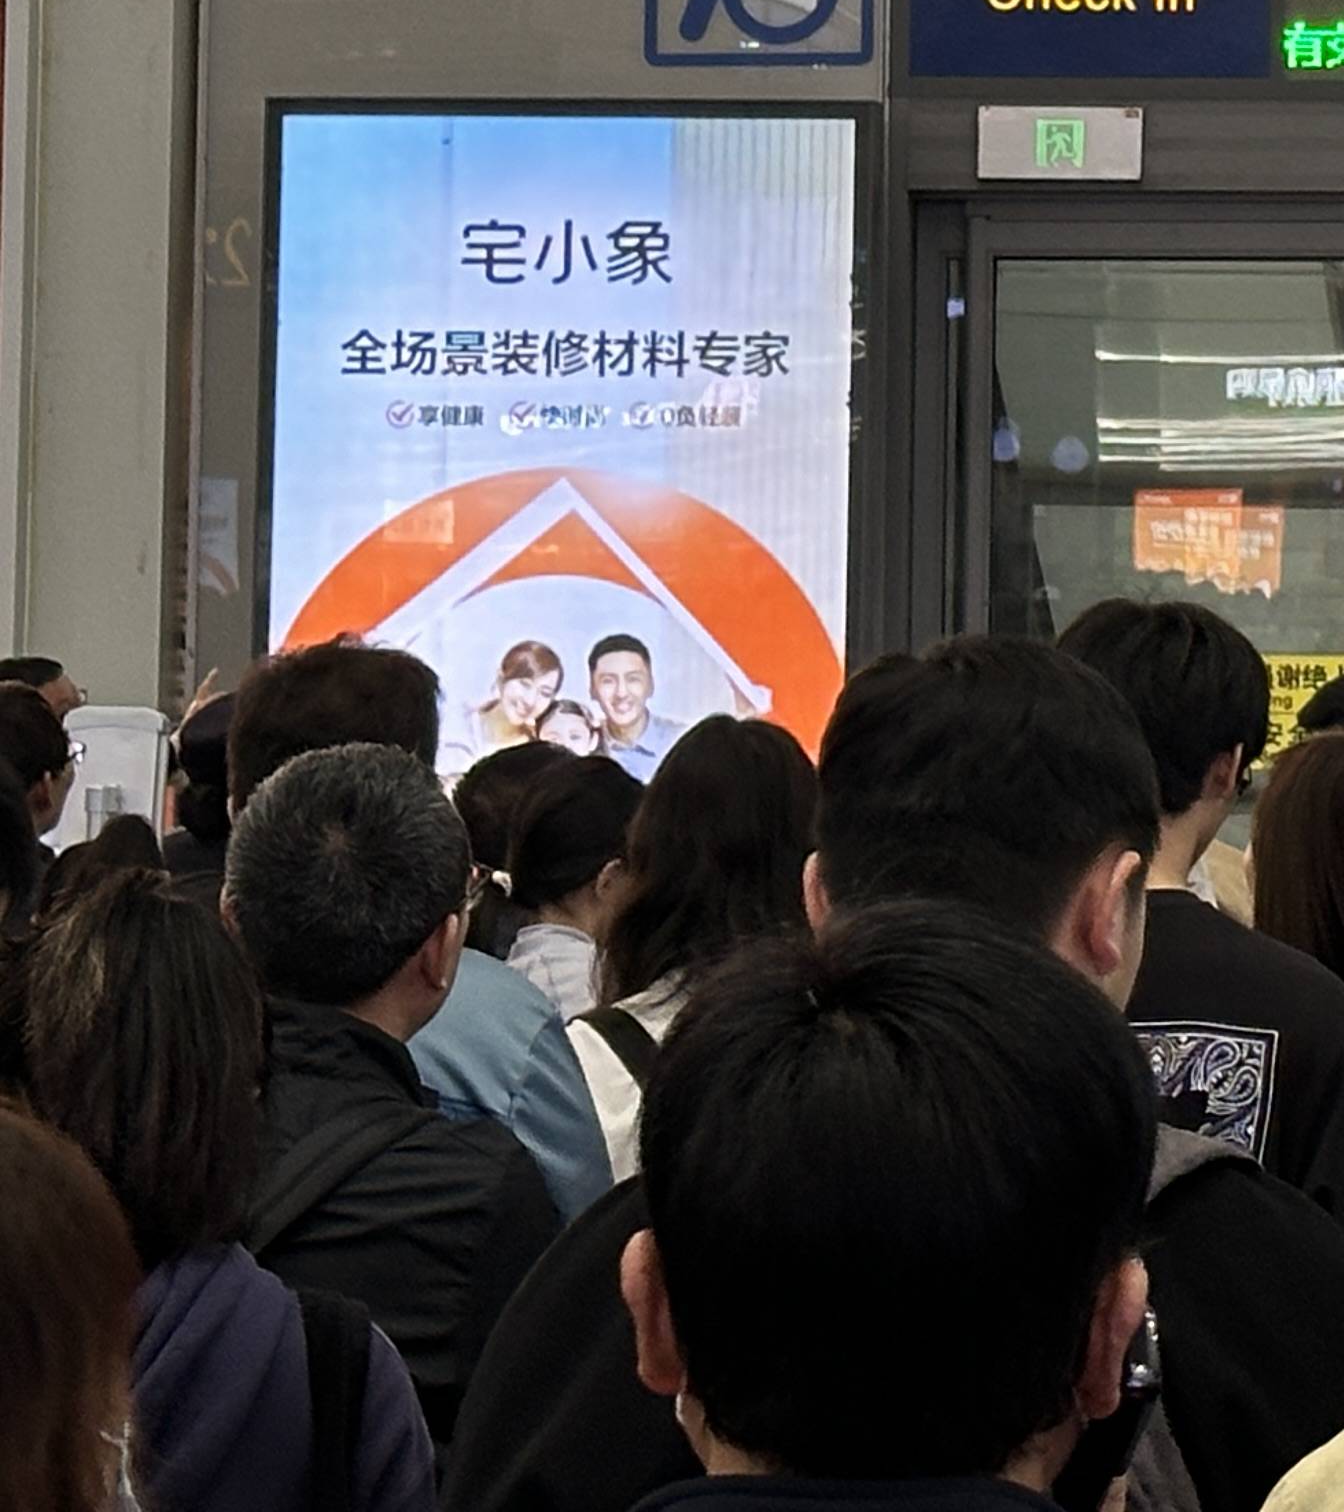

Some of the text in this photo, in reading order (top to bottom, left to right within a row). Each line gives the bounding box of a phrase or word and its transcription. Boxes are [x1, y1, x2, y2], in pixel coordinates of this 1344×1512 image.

[462, 220, 673, 286] 宅小象
[342, 330, 791, 379] 全场景装修材料专家
